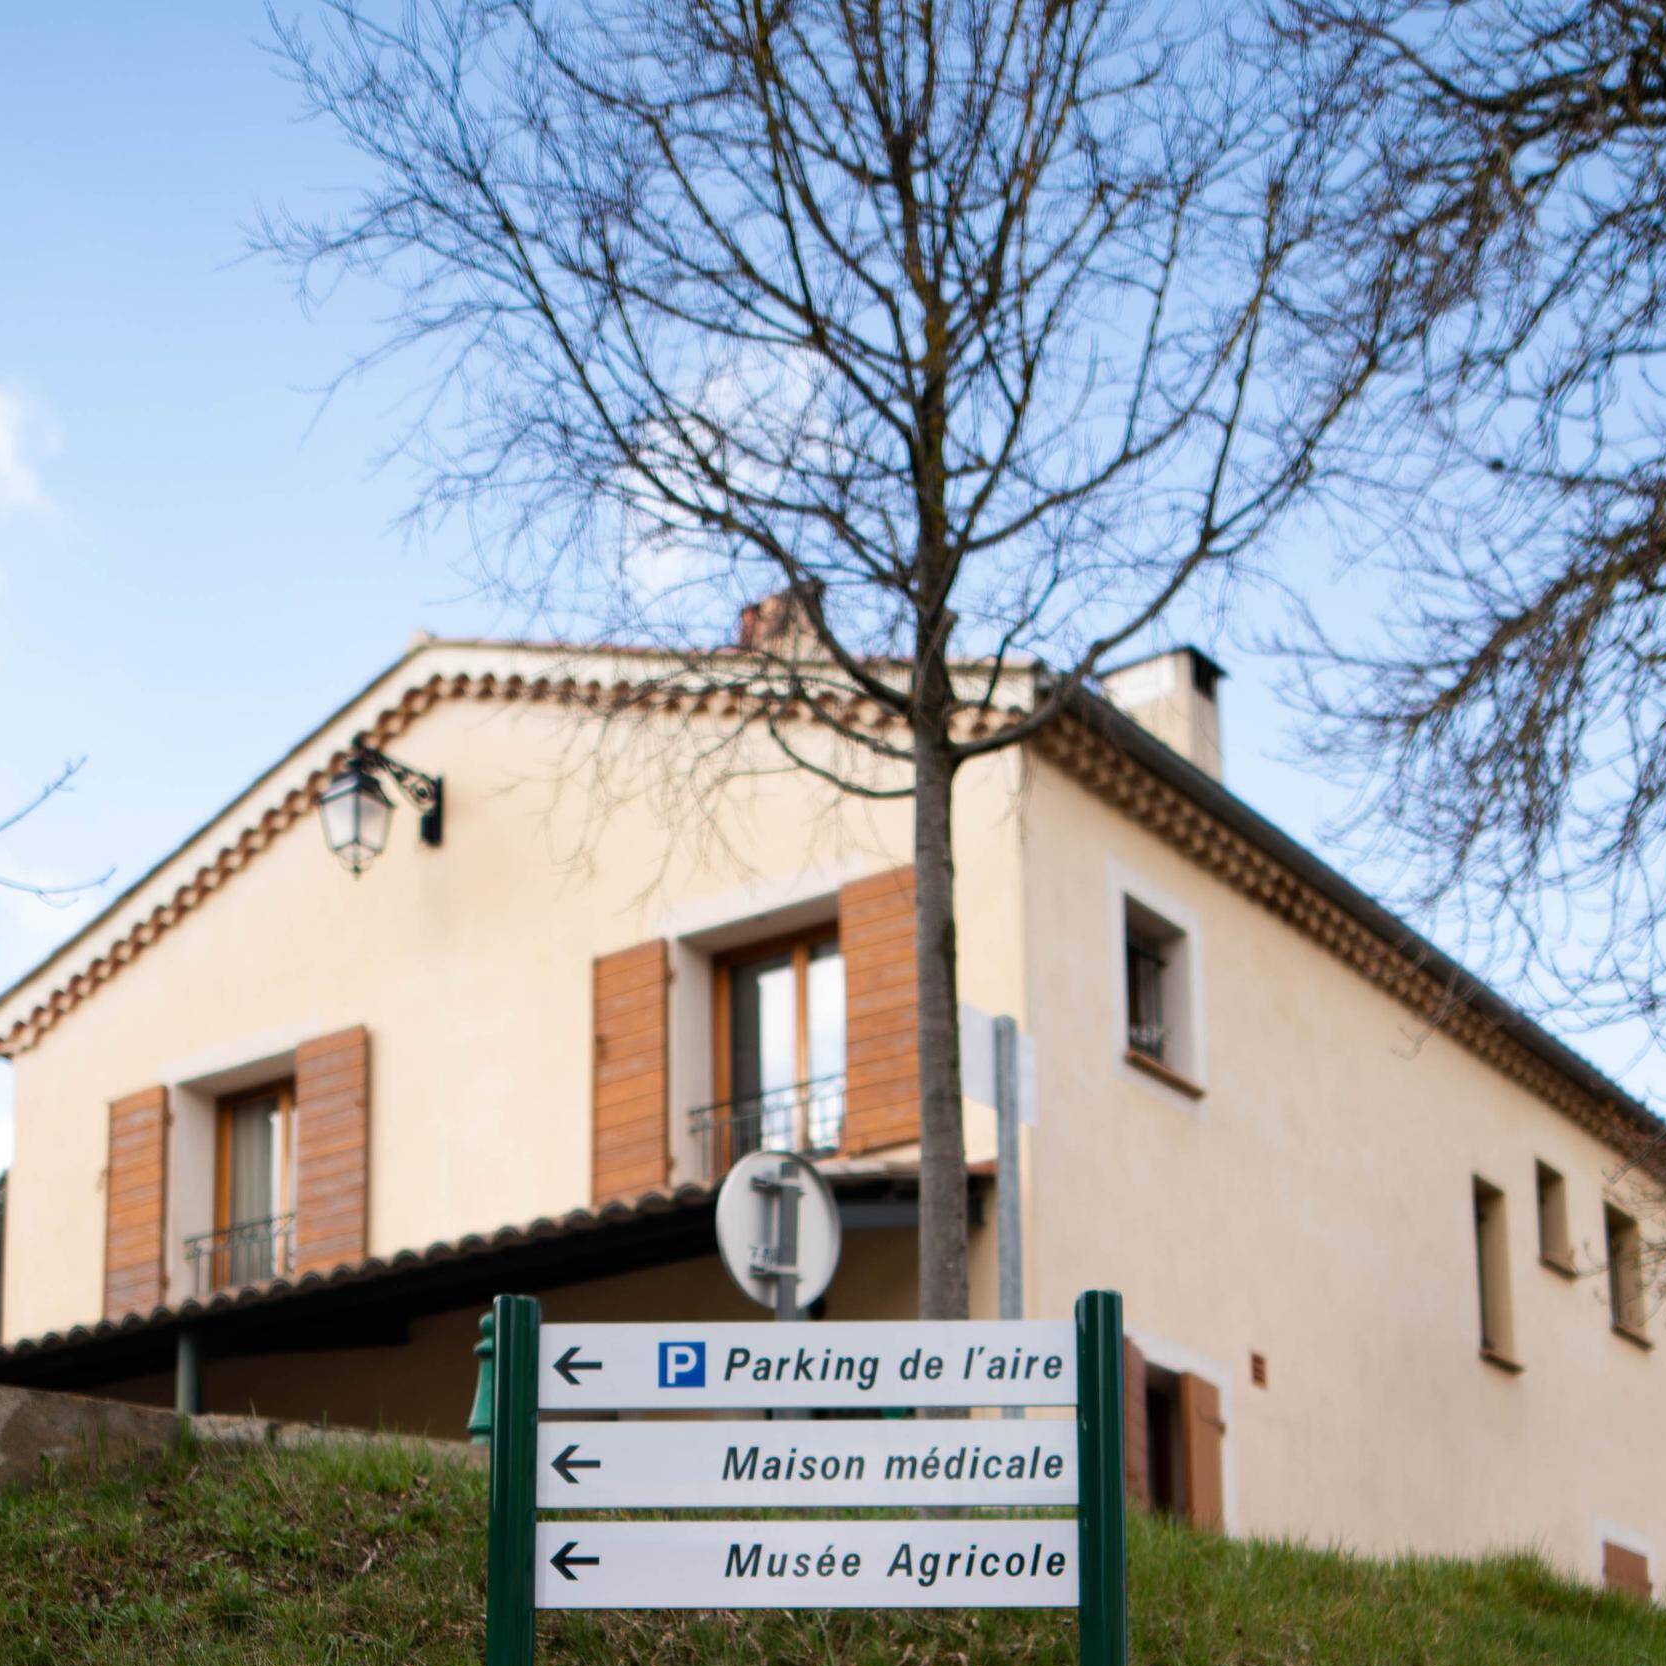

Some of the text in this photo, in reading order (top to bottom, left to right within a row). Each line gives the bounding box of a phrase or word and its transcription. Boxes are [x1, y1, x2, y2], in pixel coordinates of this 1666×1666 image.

[725, 1348, 878, 1390] Parking
[900, 1349, 942, 1380] de
[965, 1347, 1062, 1379] l'aire
[723, 1447, 1062, 1480] Maison médicale
[725, 1544, 1065, 1587] Musée Agricole
